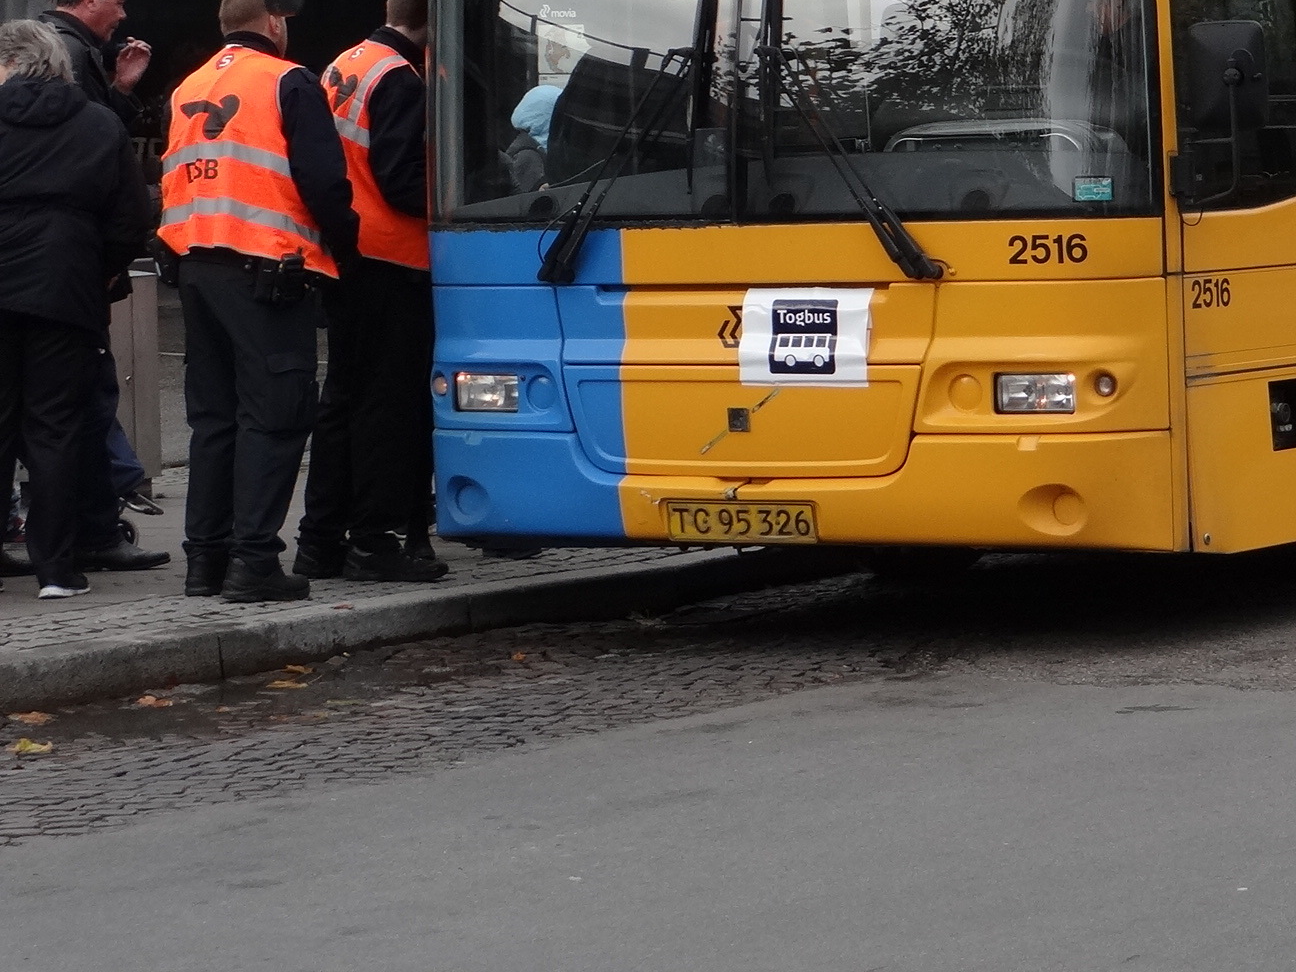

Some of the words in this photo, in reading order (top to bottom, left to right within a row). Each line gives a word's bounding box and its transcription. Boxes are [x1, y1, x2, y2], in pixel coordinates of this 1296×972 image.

[551, 8, 577, 18] movia
[218, 55, 234, 68] S
[1008, 233, 1088, 265] 2516
[1191, 278, 1232, 309] 2516
[777, 309, 832, 326] Togbus
[718, 508, 751, 535] 95
[756, 509, 812, 537] 326
